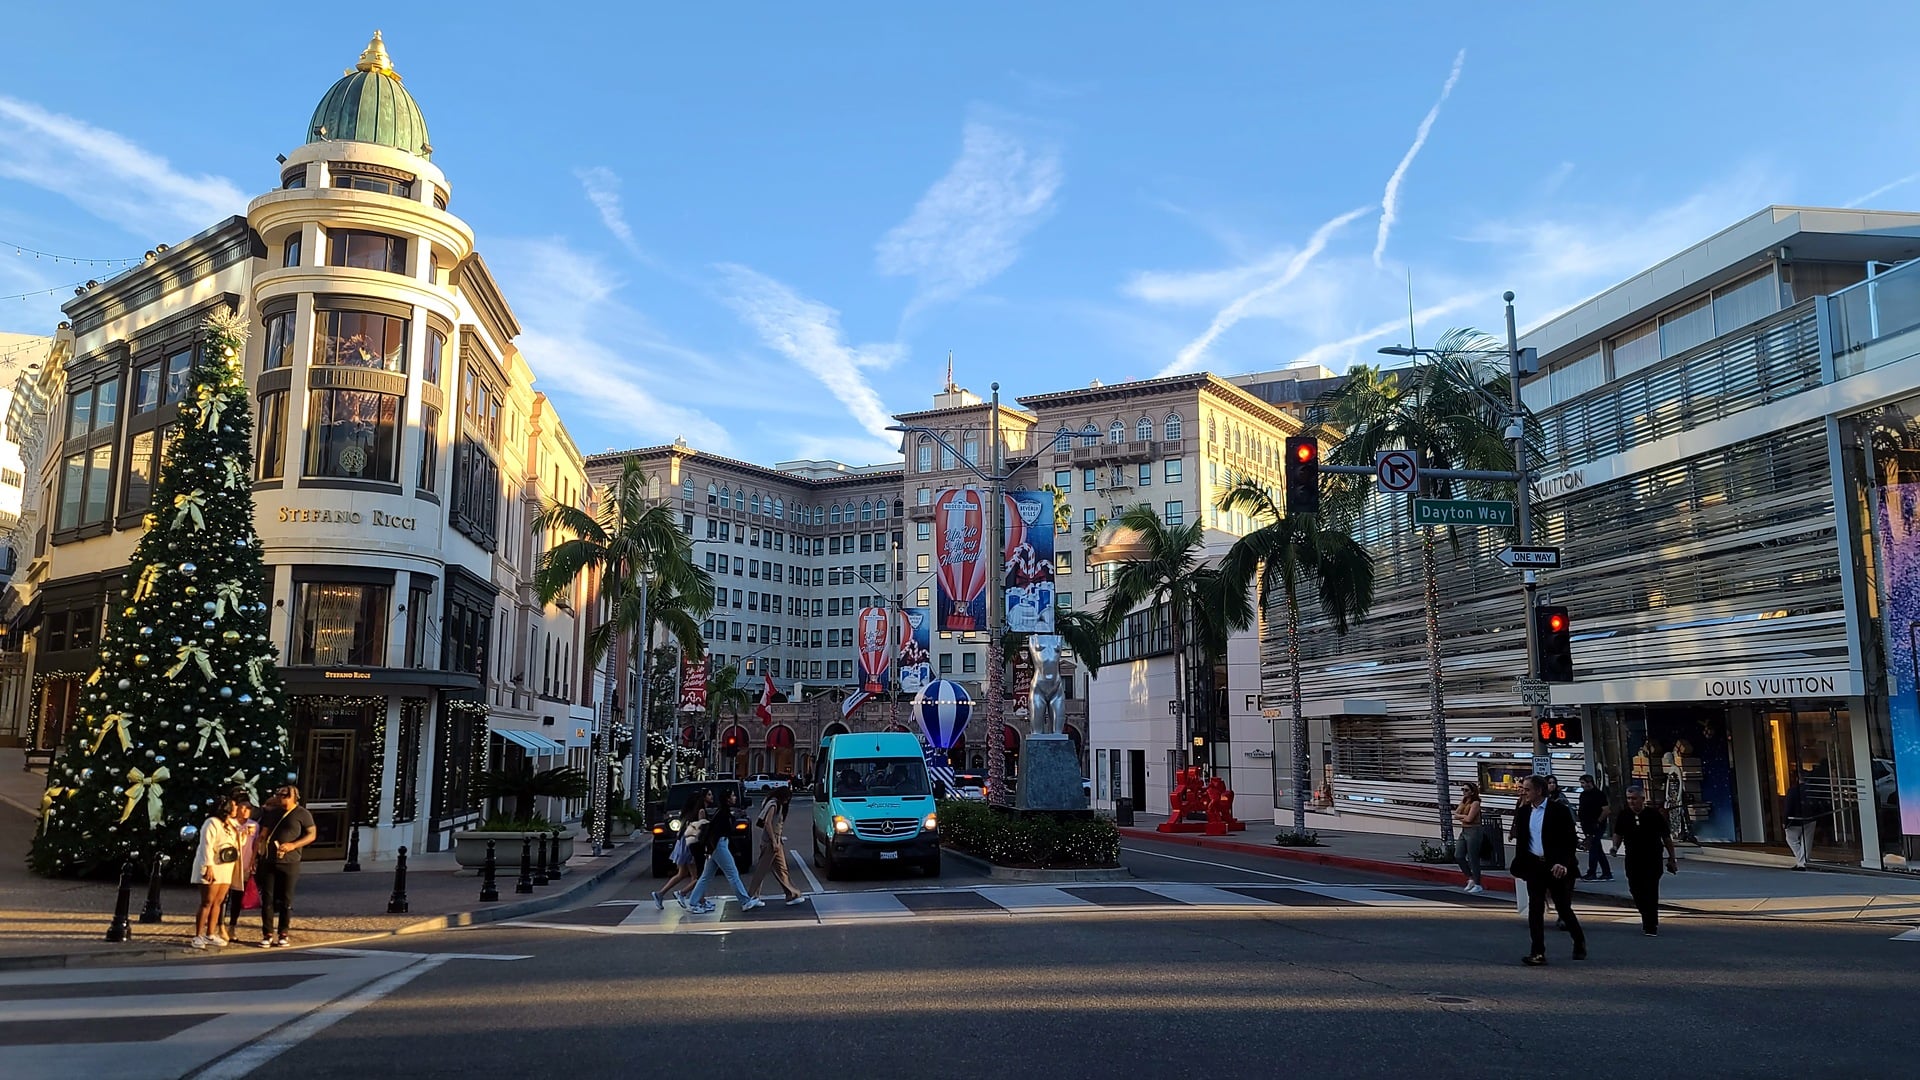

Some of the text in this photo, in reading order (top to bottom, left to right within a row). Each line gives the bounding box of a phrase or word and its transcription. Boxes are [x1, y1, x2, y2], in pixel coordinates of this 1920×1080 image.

[279, 506, 417, 530] STEFANO RICCI
[1422, 505, 1506, 522] Dayton Way
[1514, 552, 1552, 561] ONE WAY
[1705, 676, 1834, 697] LOUIS VUITTON
[1524, 693, 1534, 702] OK
